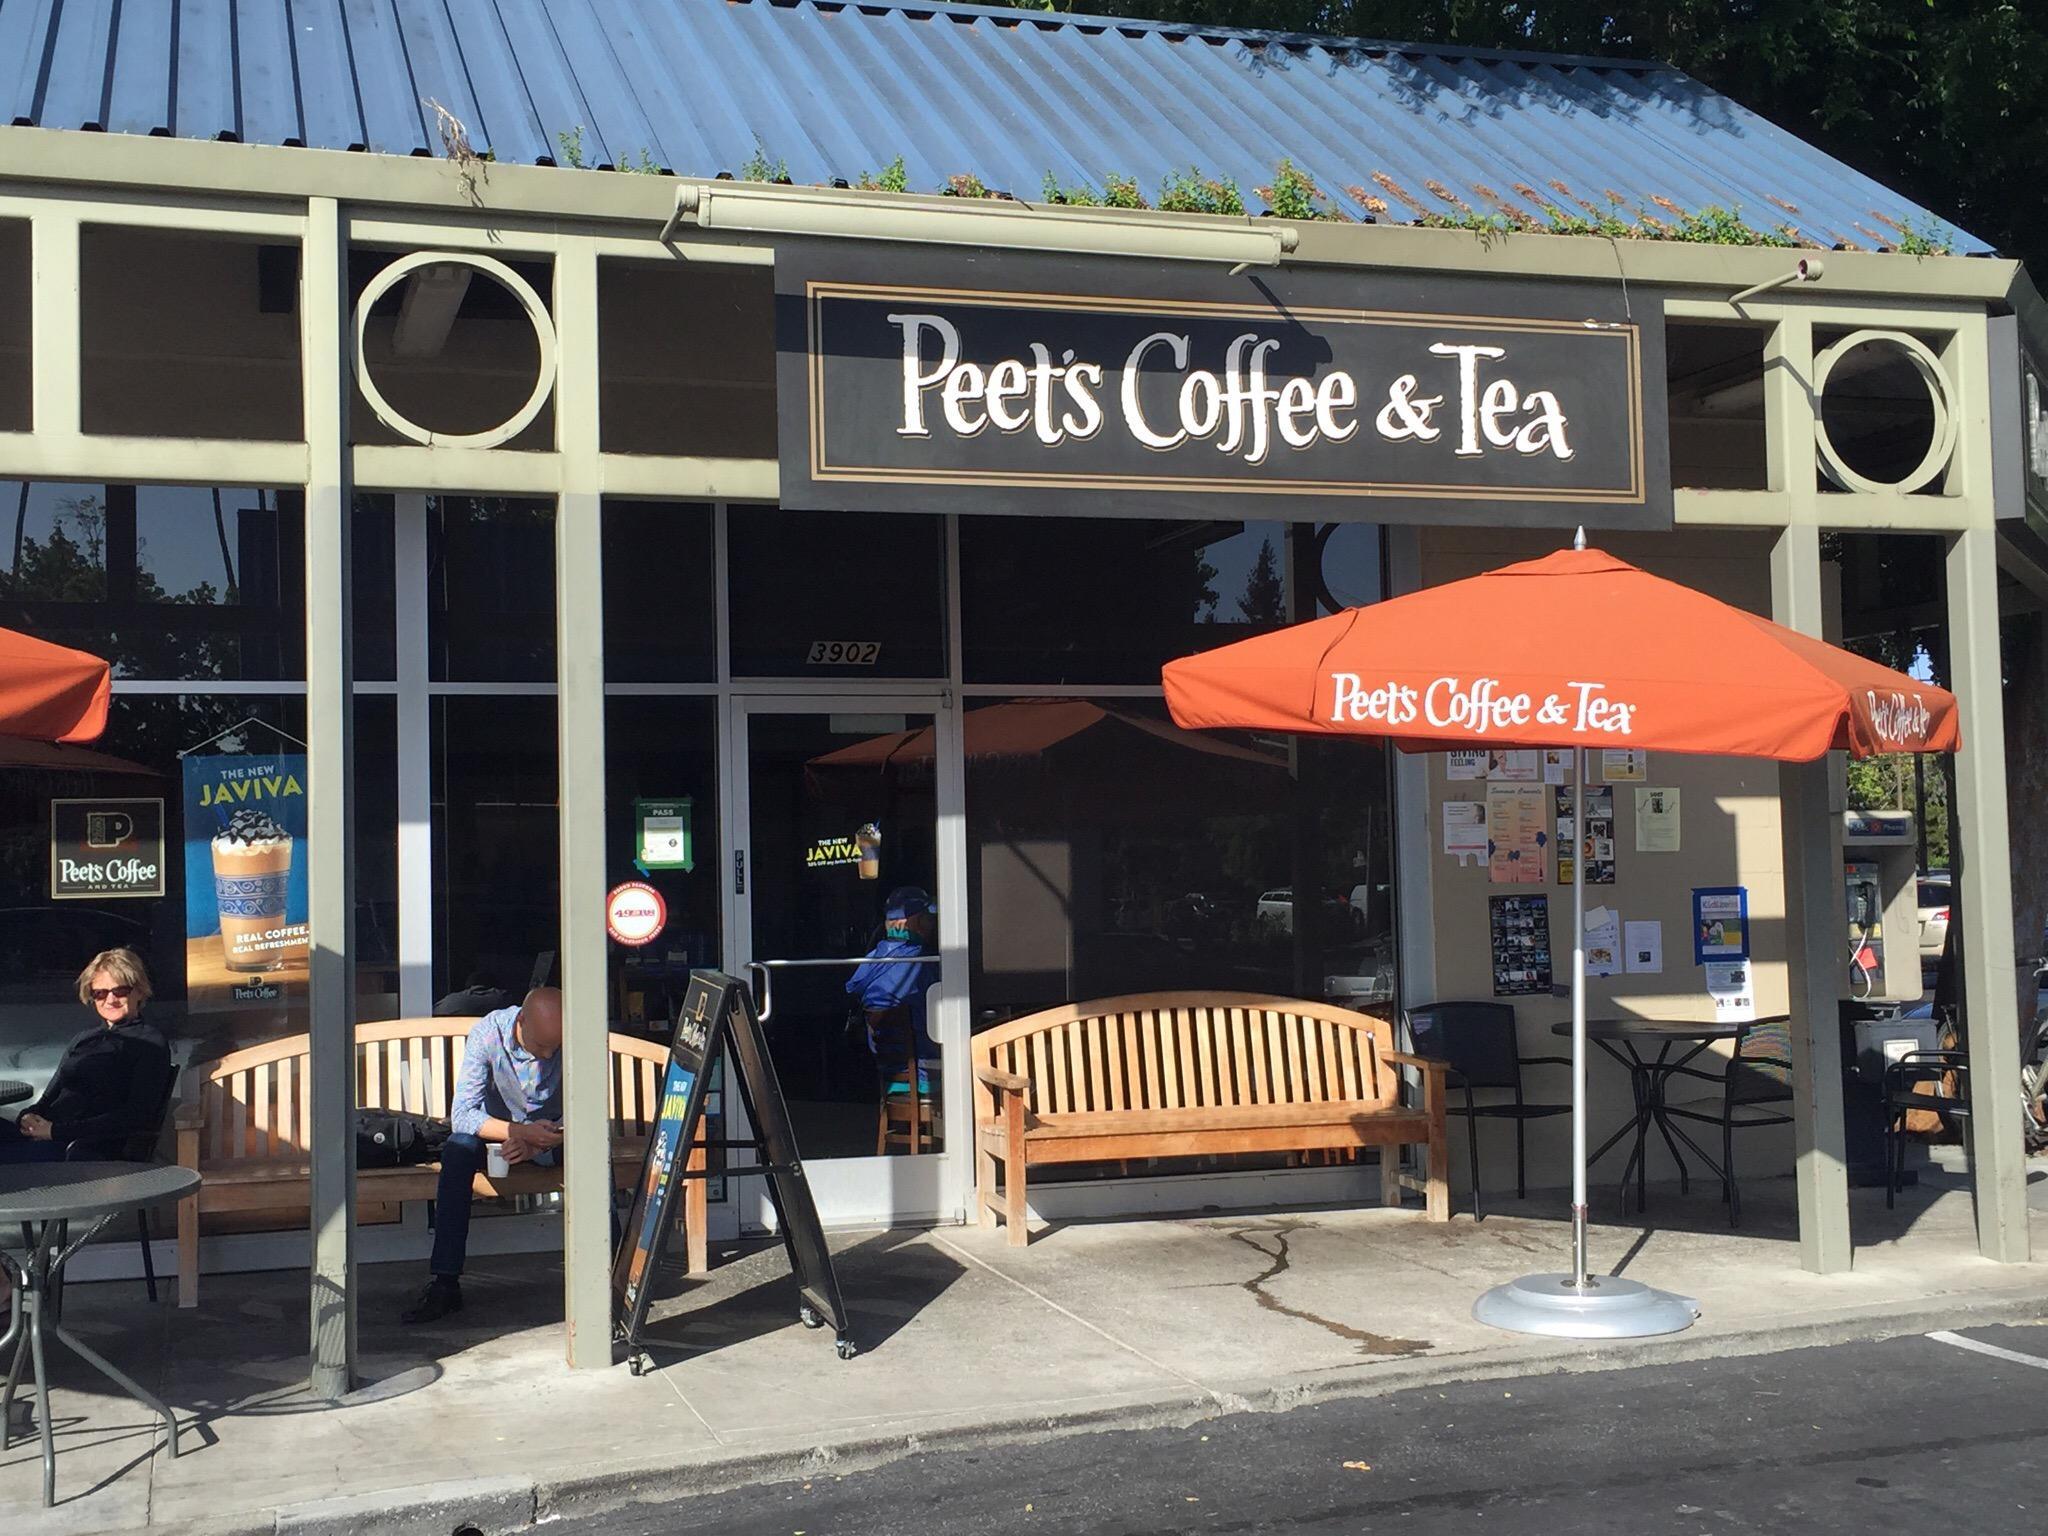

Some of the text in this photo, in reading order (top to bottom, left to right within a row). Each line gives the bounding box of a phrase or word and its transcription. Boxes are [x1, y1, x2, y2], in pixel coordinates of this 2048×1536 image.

[887, 314, 1573, 462] Peet's Coffee & Tea
[811, 643, 876, 662] 3902
[1331, 673, 1633, 735] Peet's Coffee & Tea
[220, 765, 274, 780] THE NEW
[199, 774, 303, 806] JAVIVA
[806, 843, 863, 862] JAVIVA
[59, 858, 157, 884] Peet's Coffee
[236, 926, 310, 944] REAL COFFEE.
[232, 937, 309, 954] REAL REFRESHMEN
